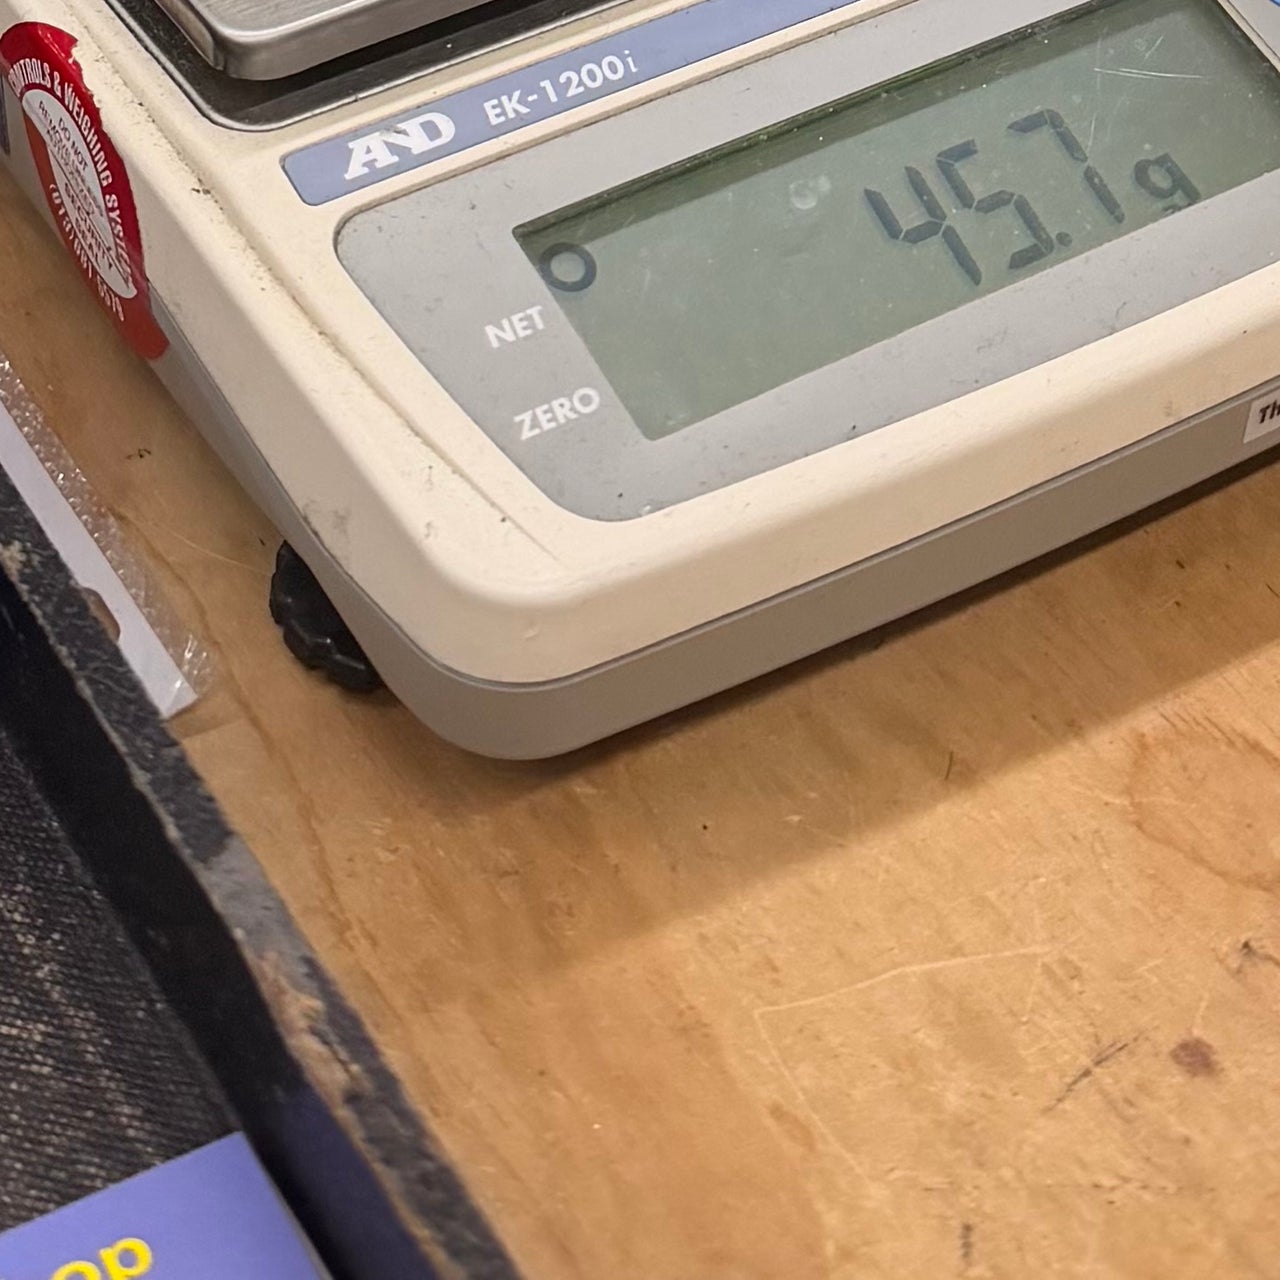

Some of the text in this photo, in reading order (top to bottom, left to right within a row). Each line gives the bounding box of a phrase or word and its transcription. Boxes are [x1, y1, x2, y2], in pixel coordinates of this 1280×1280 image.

[483, 50, 639, 126] EK-1200i
[863, 108, 1126, 287] 45.7
[484, 304, 546, 348] NET
[513, 386, 601, 441] ZERO
